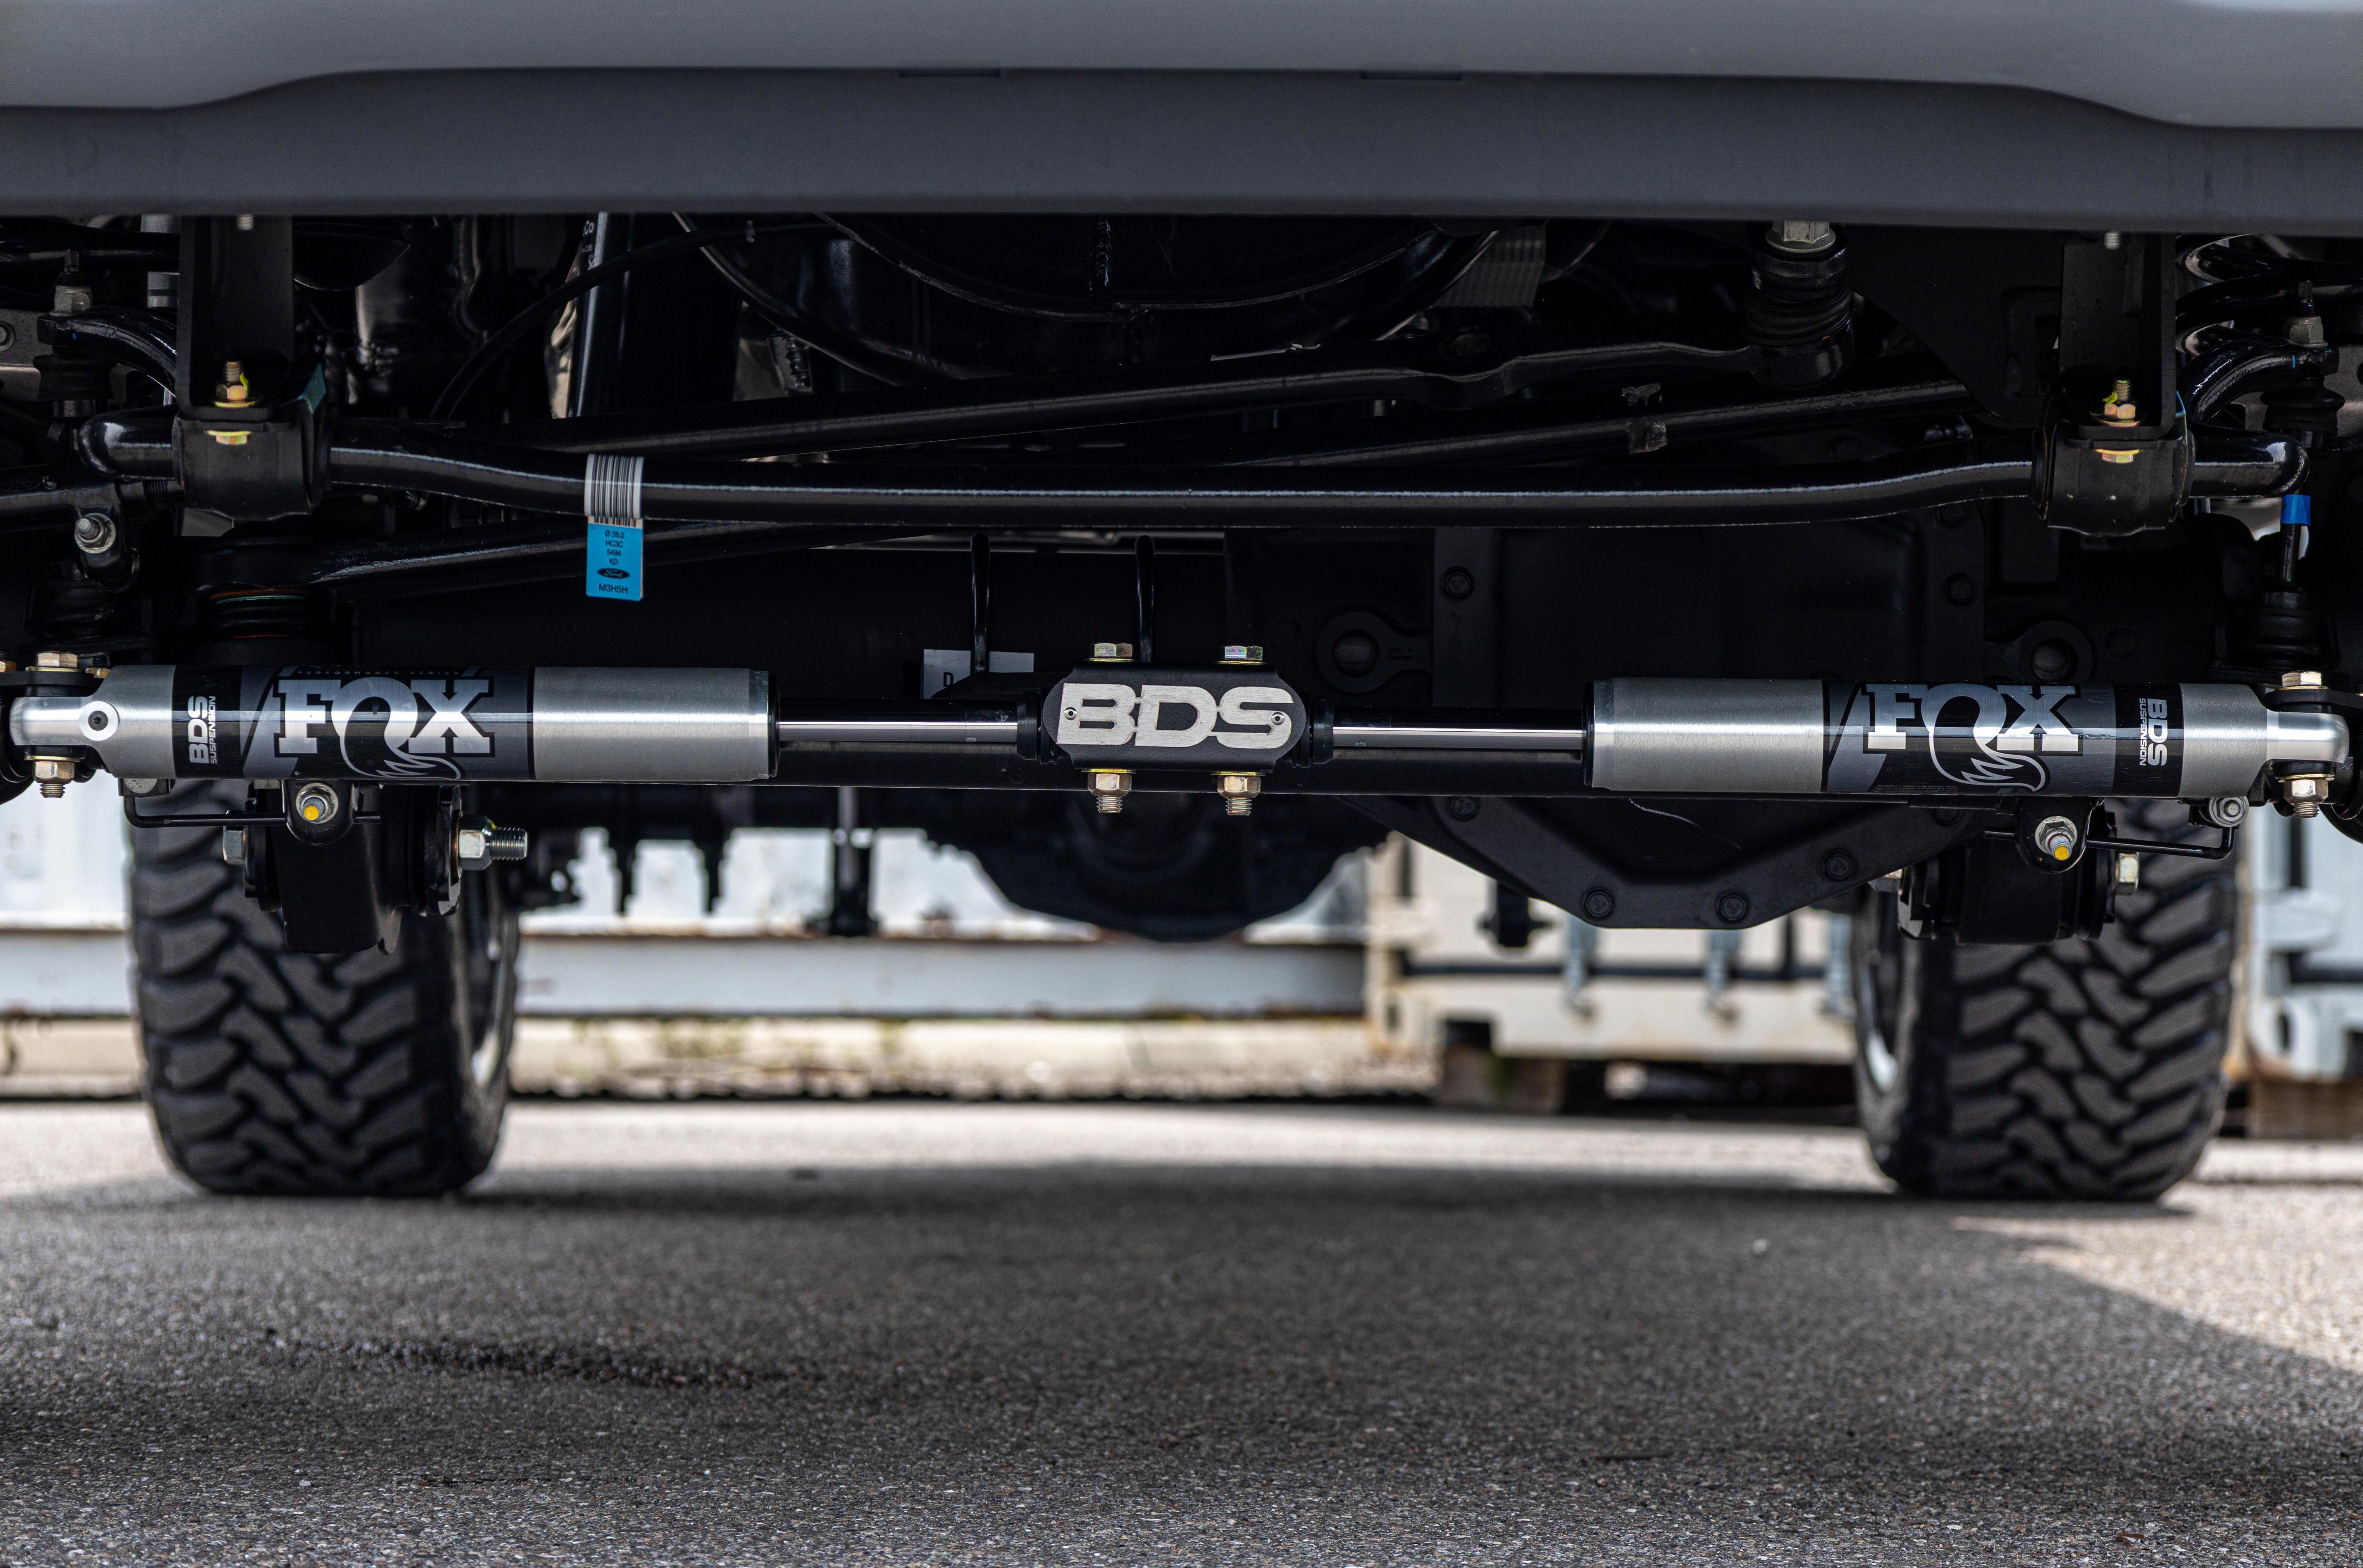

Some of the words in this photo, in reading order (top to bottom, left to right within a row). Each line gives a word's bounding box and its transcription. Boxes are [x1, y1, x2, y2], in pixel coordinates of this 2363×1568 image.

[605, 539, 623, 548] HC3C
[611, 531, 625, 539] 28.0
[187, 696, 210, 764] BDS
[208, 696, 217, 764] SUSPENSION
[278, 677, 490, 780] FOX
[1056, 683, 1294, 749] BDS
[1865, 683, 2079, 791] FOX
[2139, 698, 2148, 766] SUSPENSION
[2147, 698, 2168, 766] BDS
